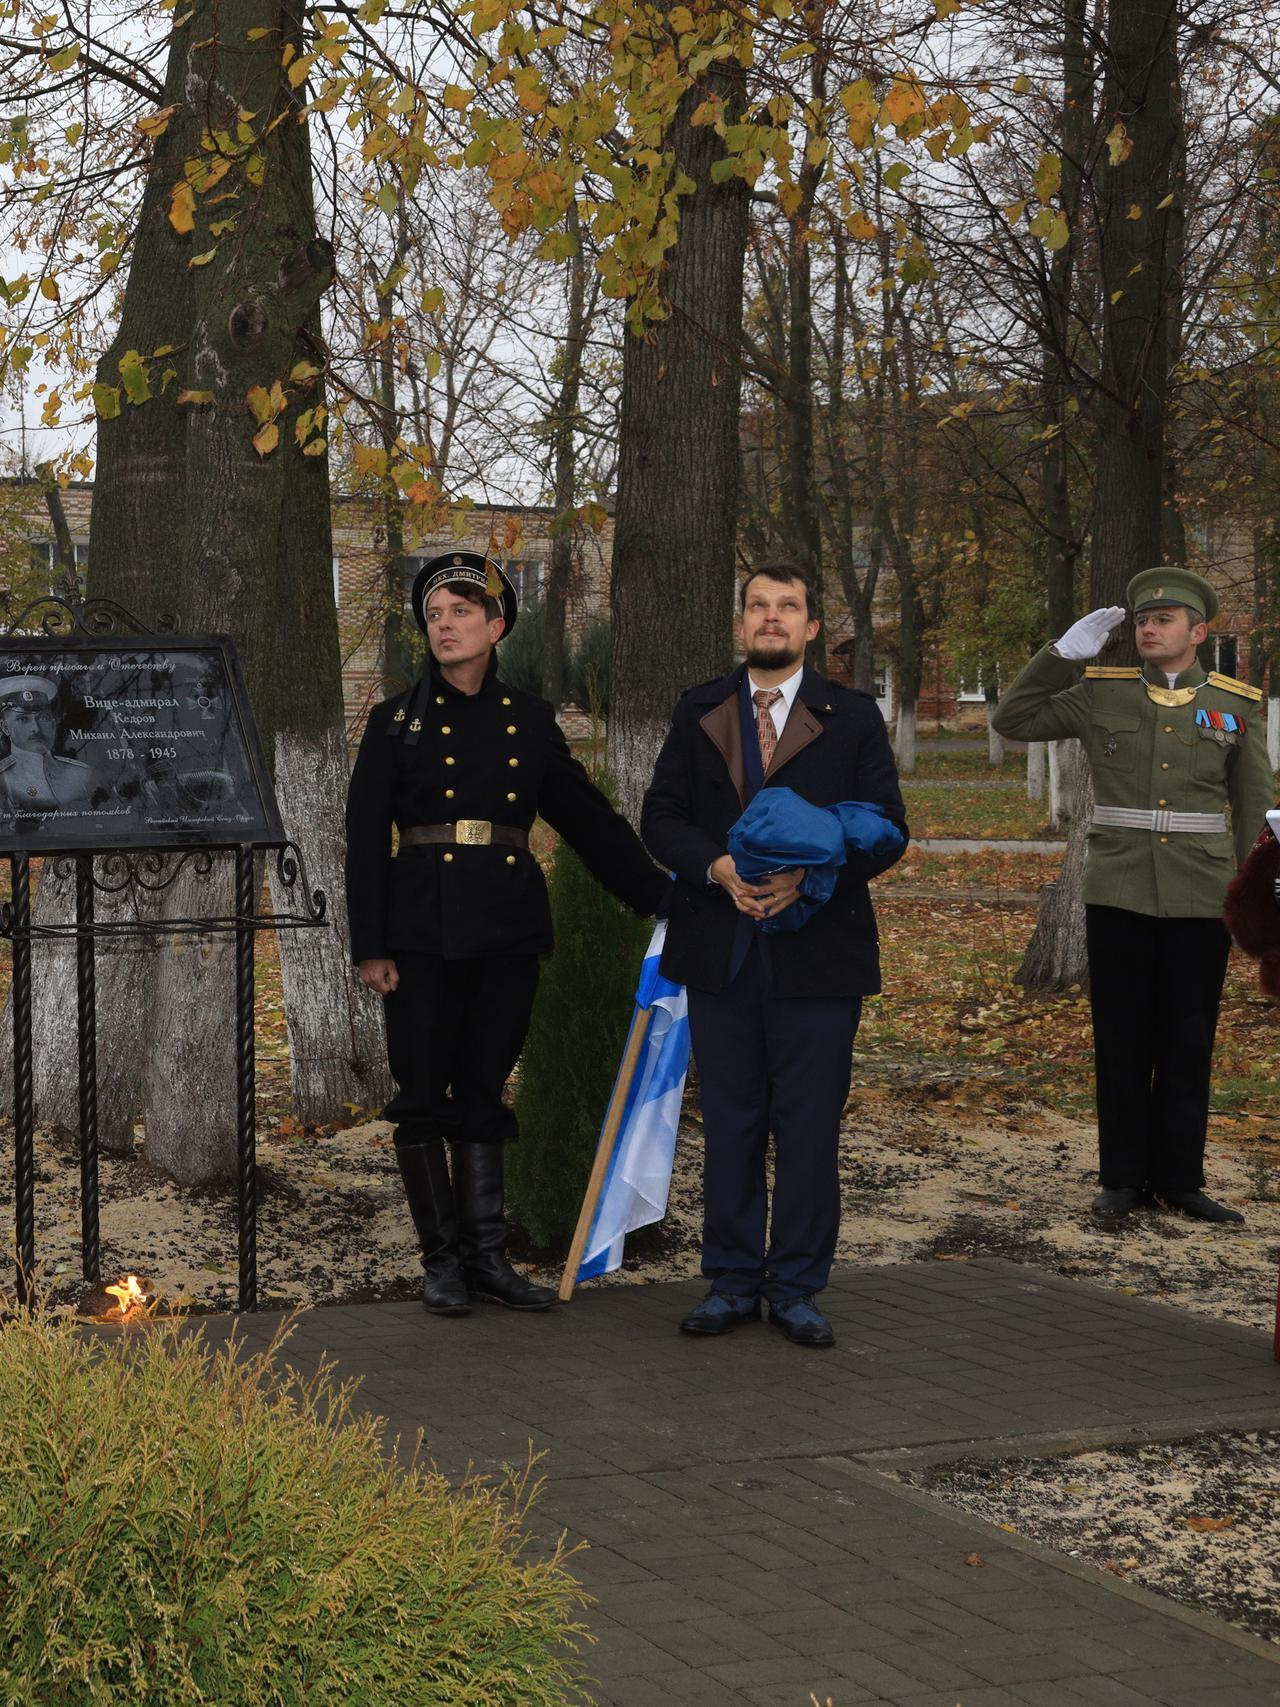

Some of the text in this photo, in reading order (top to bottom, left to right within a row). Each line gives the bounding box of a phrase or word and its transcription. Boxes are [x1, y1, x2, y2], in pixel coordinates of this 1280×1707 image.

[6, 659, 47, 676] Верен
[108, 656, 177, 674] Отечеству
[83, 695, 180, 710] Вице-адмирал
[113, 712, 156, 726] Кедров
[69, 728, 206, 741] Михаил Александрович
[106, 748, 135, 761] 1878
[149, 747, 177, 759] 1945
[14, 809, 79, 821] благодарных
[81, 805, 132, 817] потомков
